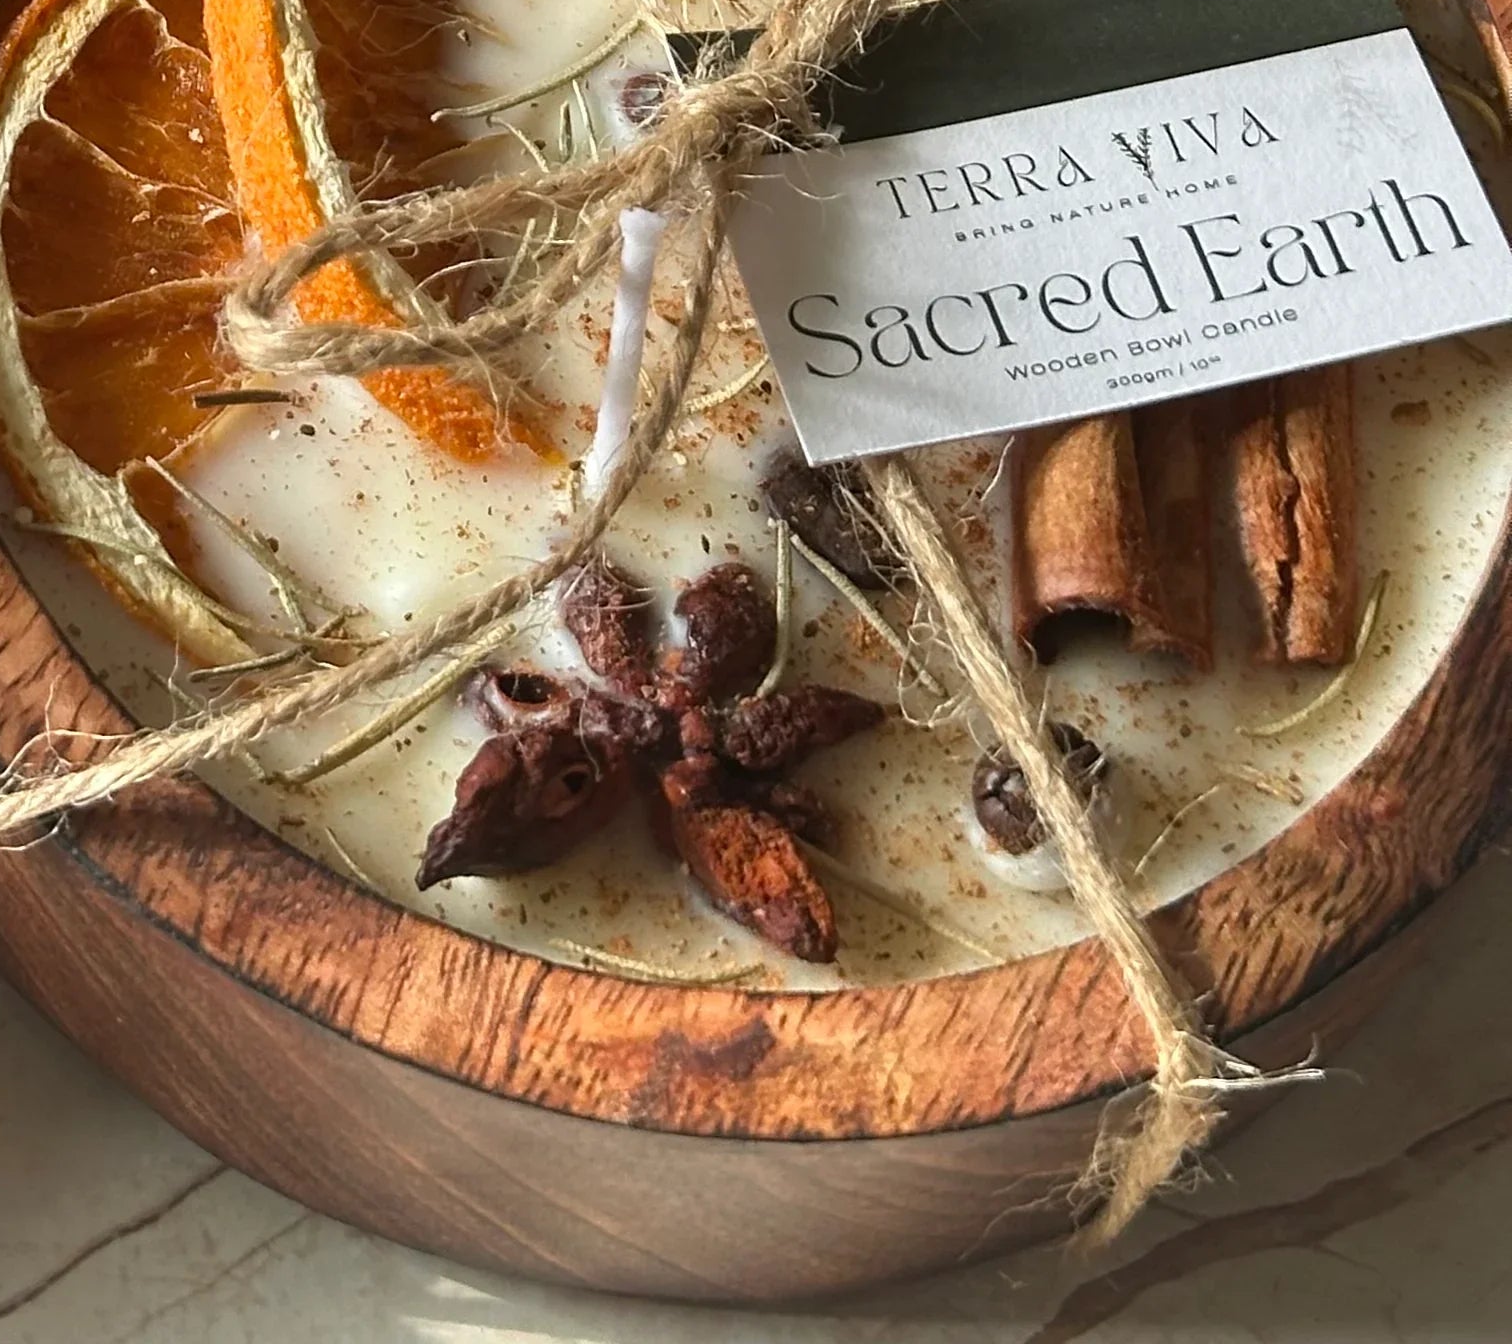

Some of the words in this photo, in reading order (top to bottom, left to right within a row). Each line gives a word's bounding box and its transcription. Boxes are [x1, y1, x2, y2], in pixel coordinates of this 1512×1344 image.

[875, 144, 1096, 220] TERRA
[1110, 105, 1281, 191] VIVA
[954, 217, 1035, 243] BRING
[1049, 192, 1151, 224] NATURE
[1165, 173, 1239, 200] HOME
[787, 235, 1178, 380] Sacred
[1178, 176, 1475, 304] Earth
[1004, 347, 1119, 382] Wooden
[1126, 327, 1193, 357] Bowl
[1200, 307, 1300, 340] Candle
